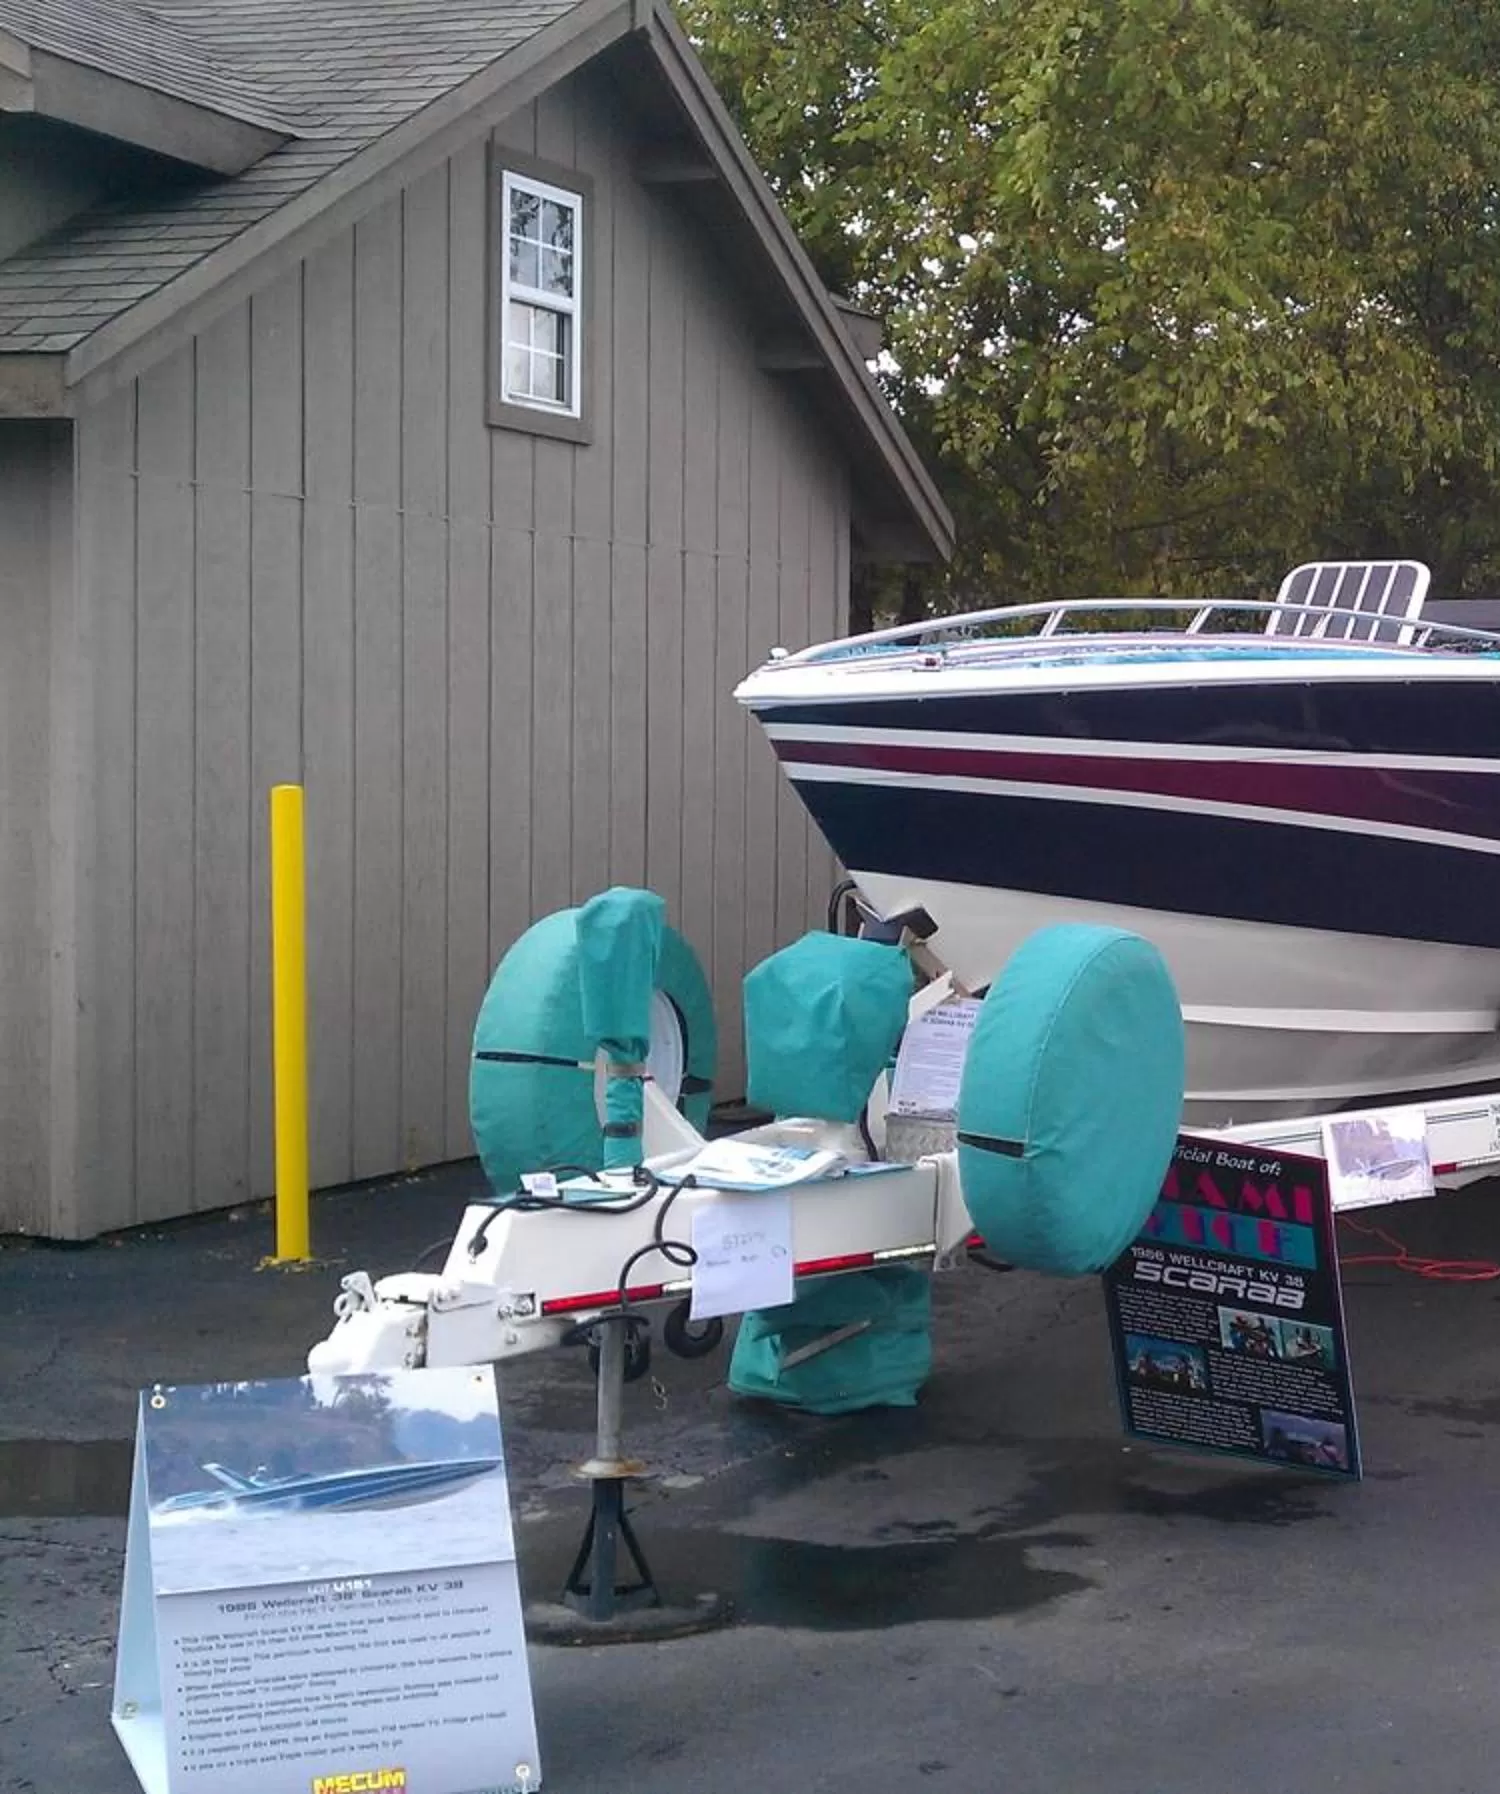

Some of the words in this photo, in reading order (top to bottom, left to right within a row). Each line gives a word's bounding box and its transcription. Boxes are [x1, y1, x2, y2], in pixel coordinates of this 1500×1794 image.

[1216, 1151, 1255, 1171] Boat
[1169, 1252, 1253, 1279] WELLCRAFT
[1259, 1269, 1279, 1284] KV
[1284, 1274, 1305, 1288] 38
[313, 1769, 406, 1793] MECUM
